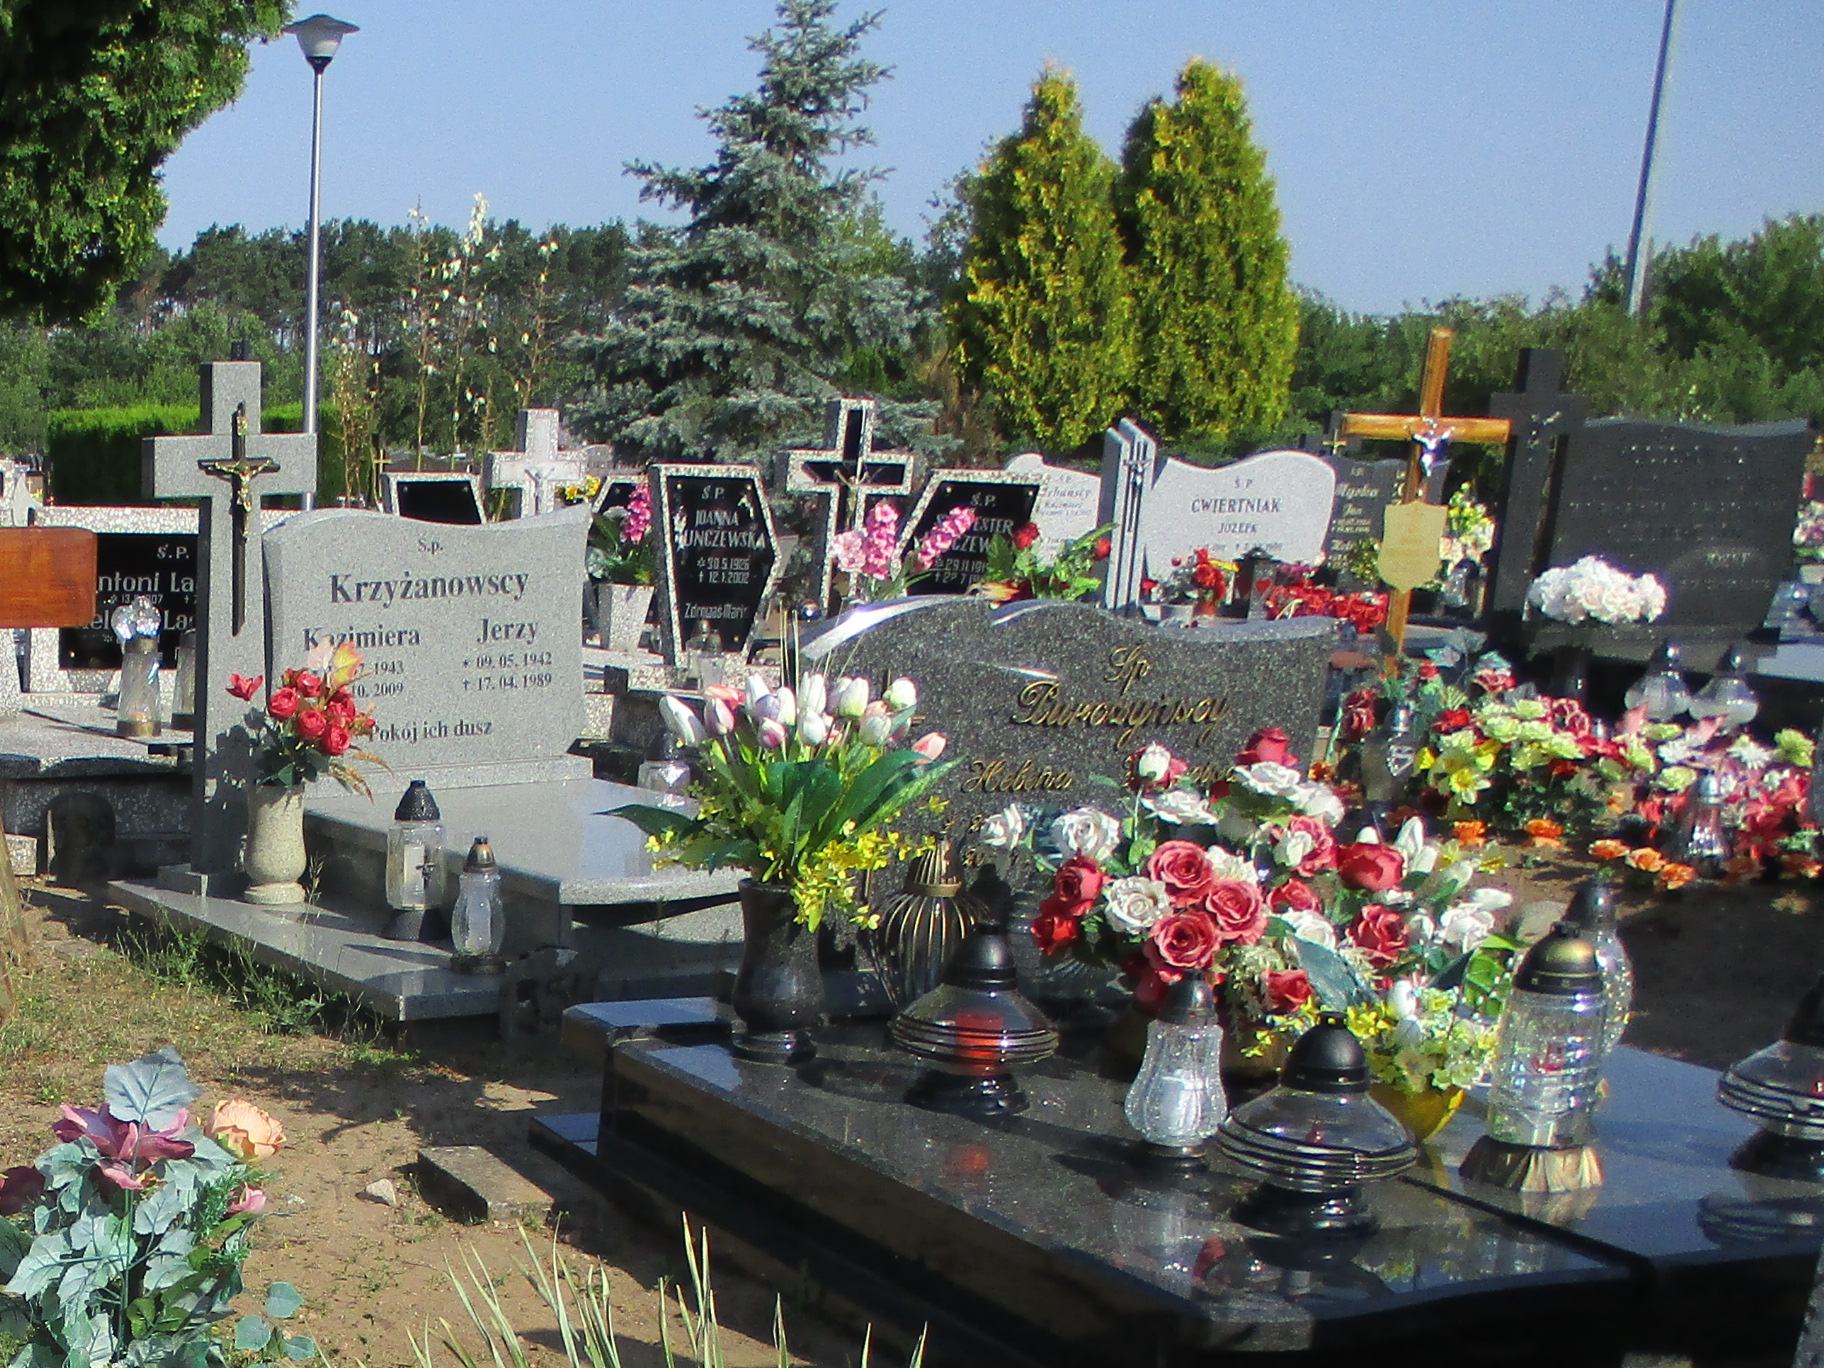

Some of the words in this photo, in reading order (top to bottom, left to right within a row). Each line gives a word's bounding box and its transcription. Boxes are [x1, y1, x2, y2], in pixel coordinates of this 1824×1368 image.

[97, 571, 160, 593] ntoni
[329, 571, 530, 609] Krzyżanowscy
[476, 617, 538, 645] Jerzy
[522, 651, 552, 667] 1942
[373, 682, 405, 697] 2009
[522, 673, 552, 688] 1989
[424, 720, 448, 739] ich
[453, 718, 493, 737] dusz
